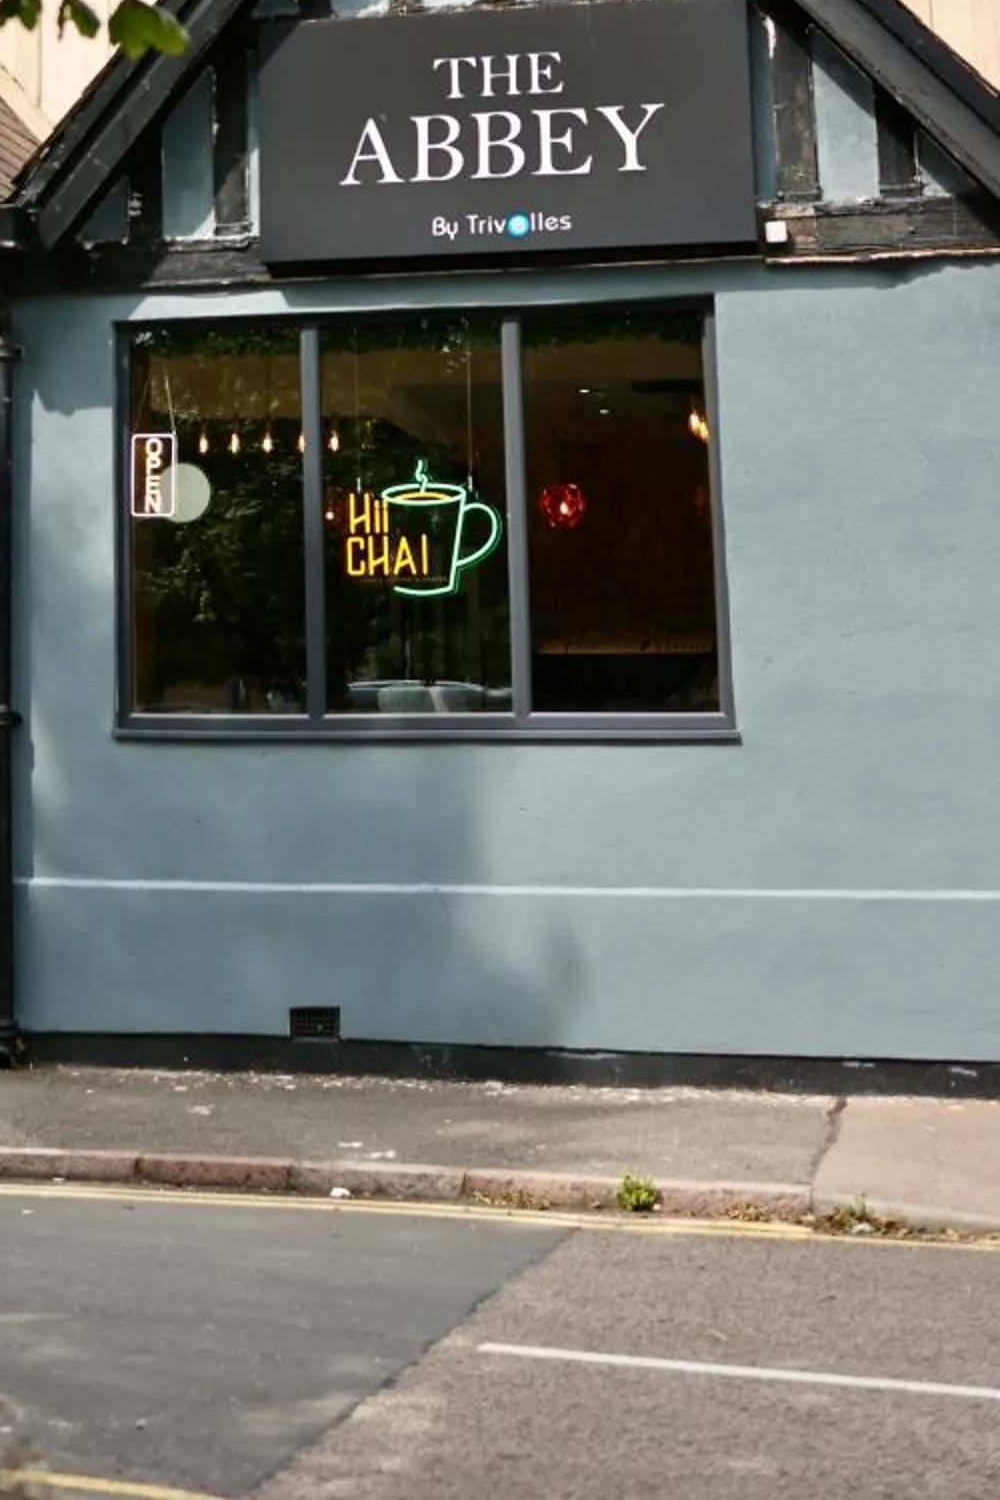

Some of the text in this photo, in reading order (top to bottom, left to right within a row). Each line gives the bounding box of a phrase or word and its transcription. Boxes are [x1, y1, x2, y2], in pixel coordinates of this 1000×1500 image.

[433, 51, 564, 99] THE
[338, 102, 665, 185] ABBEY
[431, 211, 572, 241] By Trivlles
[144, 437, 163, 513] OPEN
[346, 533, 429, 576] CHAI
